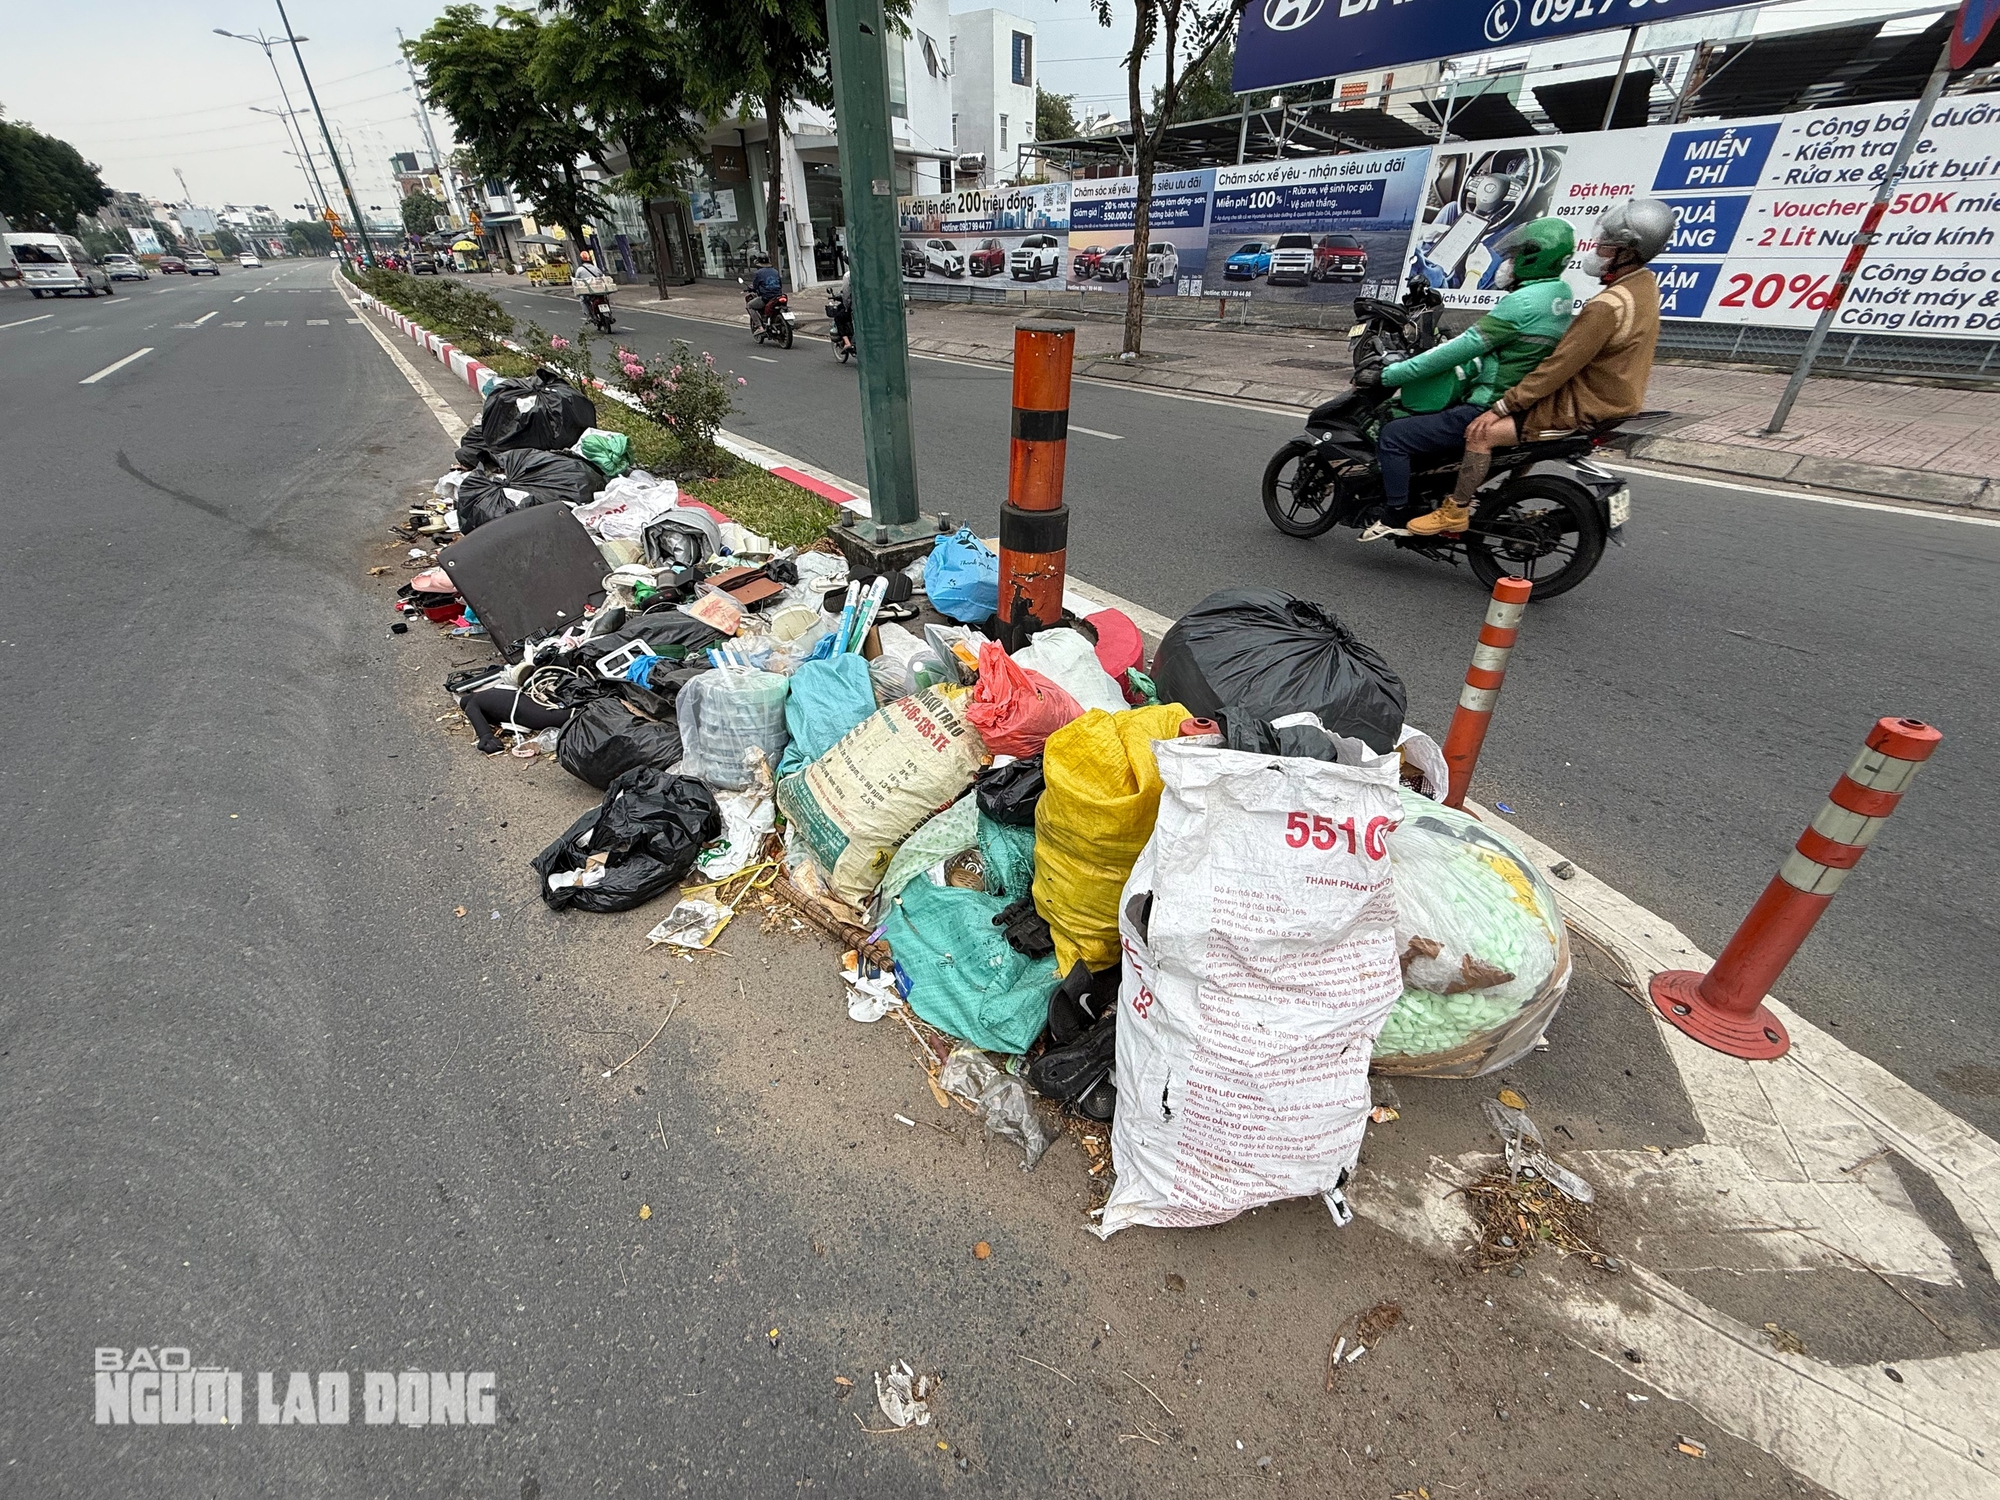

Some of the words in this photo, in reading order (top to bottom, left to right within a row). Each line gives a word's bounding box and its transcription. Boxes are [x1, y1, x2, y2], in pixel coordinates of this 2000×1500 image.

[1806, 117, 1870, 137] Công
[1683, 129, 1751, 161] MIỄN
[1794, 137, 1856, 161] Kiểm
[1861, 141, 1898, 157] tra
[1219, 172, 1246, 185] Chăm
[1249, 170, 1264, 182] sóc
[1267, 167, 1280, 181] xế
[1281, 168, 1300, 183] yêu
[1309, 164, 1337, 179] nhận
[1340, 162, 1363, 175] siêu
[1366, 161, 1381, 173] ưu
[1384, 158, 1406, 172] đãi
[1685, 159, 1733, 185] PHÍ
[1784, 164, 1832, 185] Rửa
[1834, 168, 1863, 183] xe
[1868, 164, 1887, 181] &
[1940, 156, 1991, 180] bụi
[1074, 187, 1094, 197] Chăm
[1095, 185, 1107, 195] sóc
[1108, 183, 1116, 194] xế
[1118, 183, 1131, 196] yêu
[1158, 178, 1173, 190] siêu
[1176, 179, 1186, 188] ưu
[1188, 176, 1201, 188] đãi
[1292, 184, 1306, 195] Rửa
[1320, 183, 1328, 194] vệ
[1330, 182, 1345, 193] sinh
[1347, 182, 1358, 193] lọc
[1360, 182, 1374, 194] gió.
[1570, 183, 1598, 200] Đặt
[1600, 183, 1635, 199] hẹn:
[900, 201, 910, 216] Ưu
[912, 200, 924, 215] đãi
[926, 199, 937, 215] lên
[940, 197, 956, 214] đến
[958, 192, 981, 213] 200
[982, 196, 1005, 215] triệu
[1007, 192, 1036, 212] đồng.
[1216, 195, 1235, 208] Miễn
[1236, 196, 1248, 209] phí
[1291, 198, 1299, 209] Vệ
[1300, 199, 1314, 208] sinh
[1316, 197, 1338, 209] thắng.
[1773, 199, 1868, 218] Voucher
[1073, 206, 1088, 216] Giảm
[1089, 207, 1097, 218] giá
[1104, 211, 1127, 220] 550.000
[1557, 206, 1584, 216] 0917
[1585, 206, 1599, 215] 99
[942, 222, 959, 232] Hotline:
[1757, 227, 1777, 246] 2
[1885, 225, 1928, 246] rửa
[1934, 226, 1995, 246] kính
[1861, 264, 1929, 285] Công
[1931, 262, 1987, 282] bảo
[1718, 273, 1830, 310] 20%
[1848, 287, 1912, 304] Nhớt
[1913, 288, 1976, 310] máy
[1978, 291, 1999, 307] &
[1458, 294, 1470, 306] Vụ
[1840, 308, 1906, 329] Công
[1908, 310, 1960, 328] làm
[1306, 876, 1337, 886] THÀNH
[1340, 880, 1367, 891] PHẦN
[1213, 897, 1238, 907] Protein
[1266, 893, 1281, 902] 14%
[1248, 982, 1284, 991] Methylene
[1200, 992, 1216, 1001] Hoạt
[1186, 1079, 1217, 1094] NGUYÊN
[1219, 1090, 1236, 1098] LIỆU
[1237, 1091, 1264, 1102] CHÍNH:
[1183, 1107, 1211, 1121] HƯỚNG
[1213, 1117, 1229, 1127] DẪN
[1242, 1124, 1266, 1132] DỤNG:
[1214, 1154, 1230, 1164] BẢO
